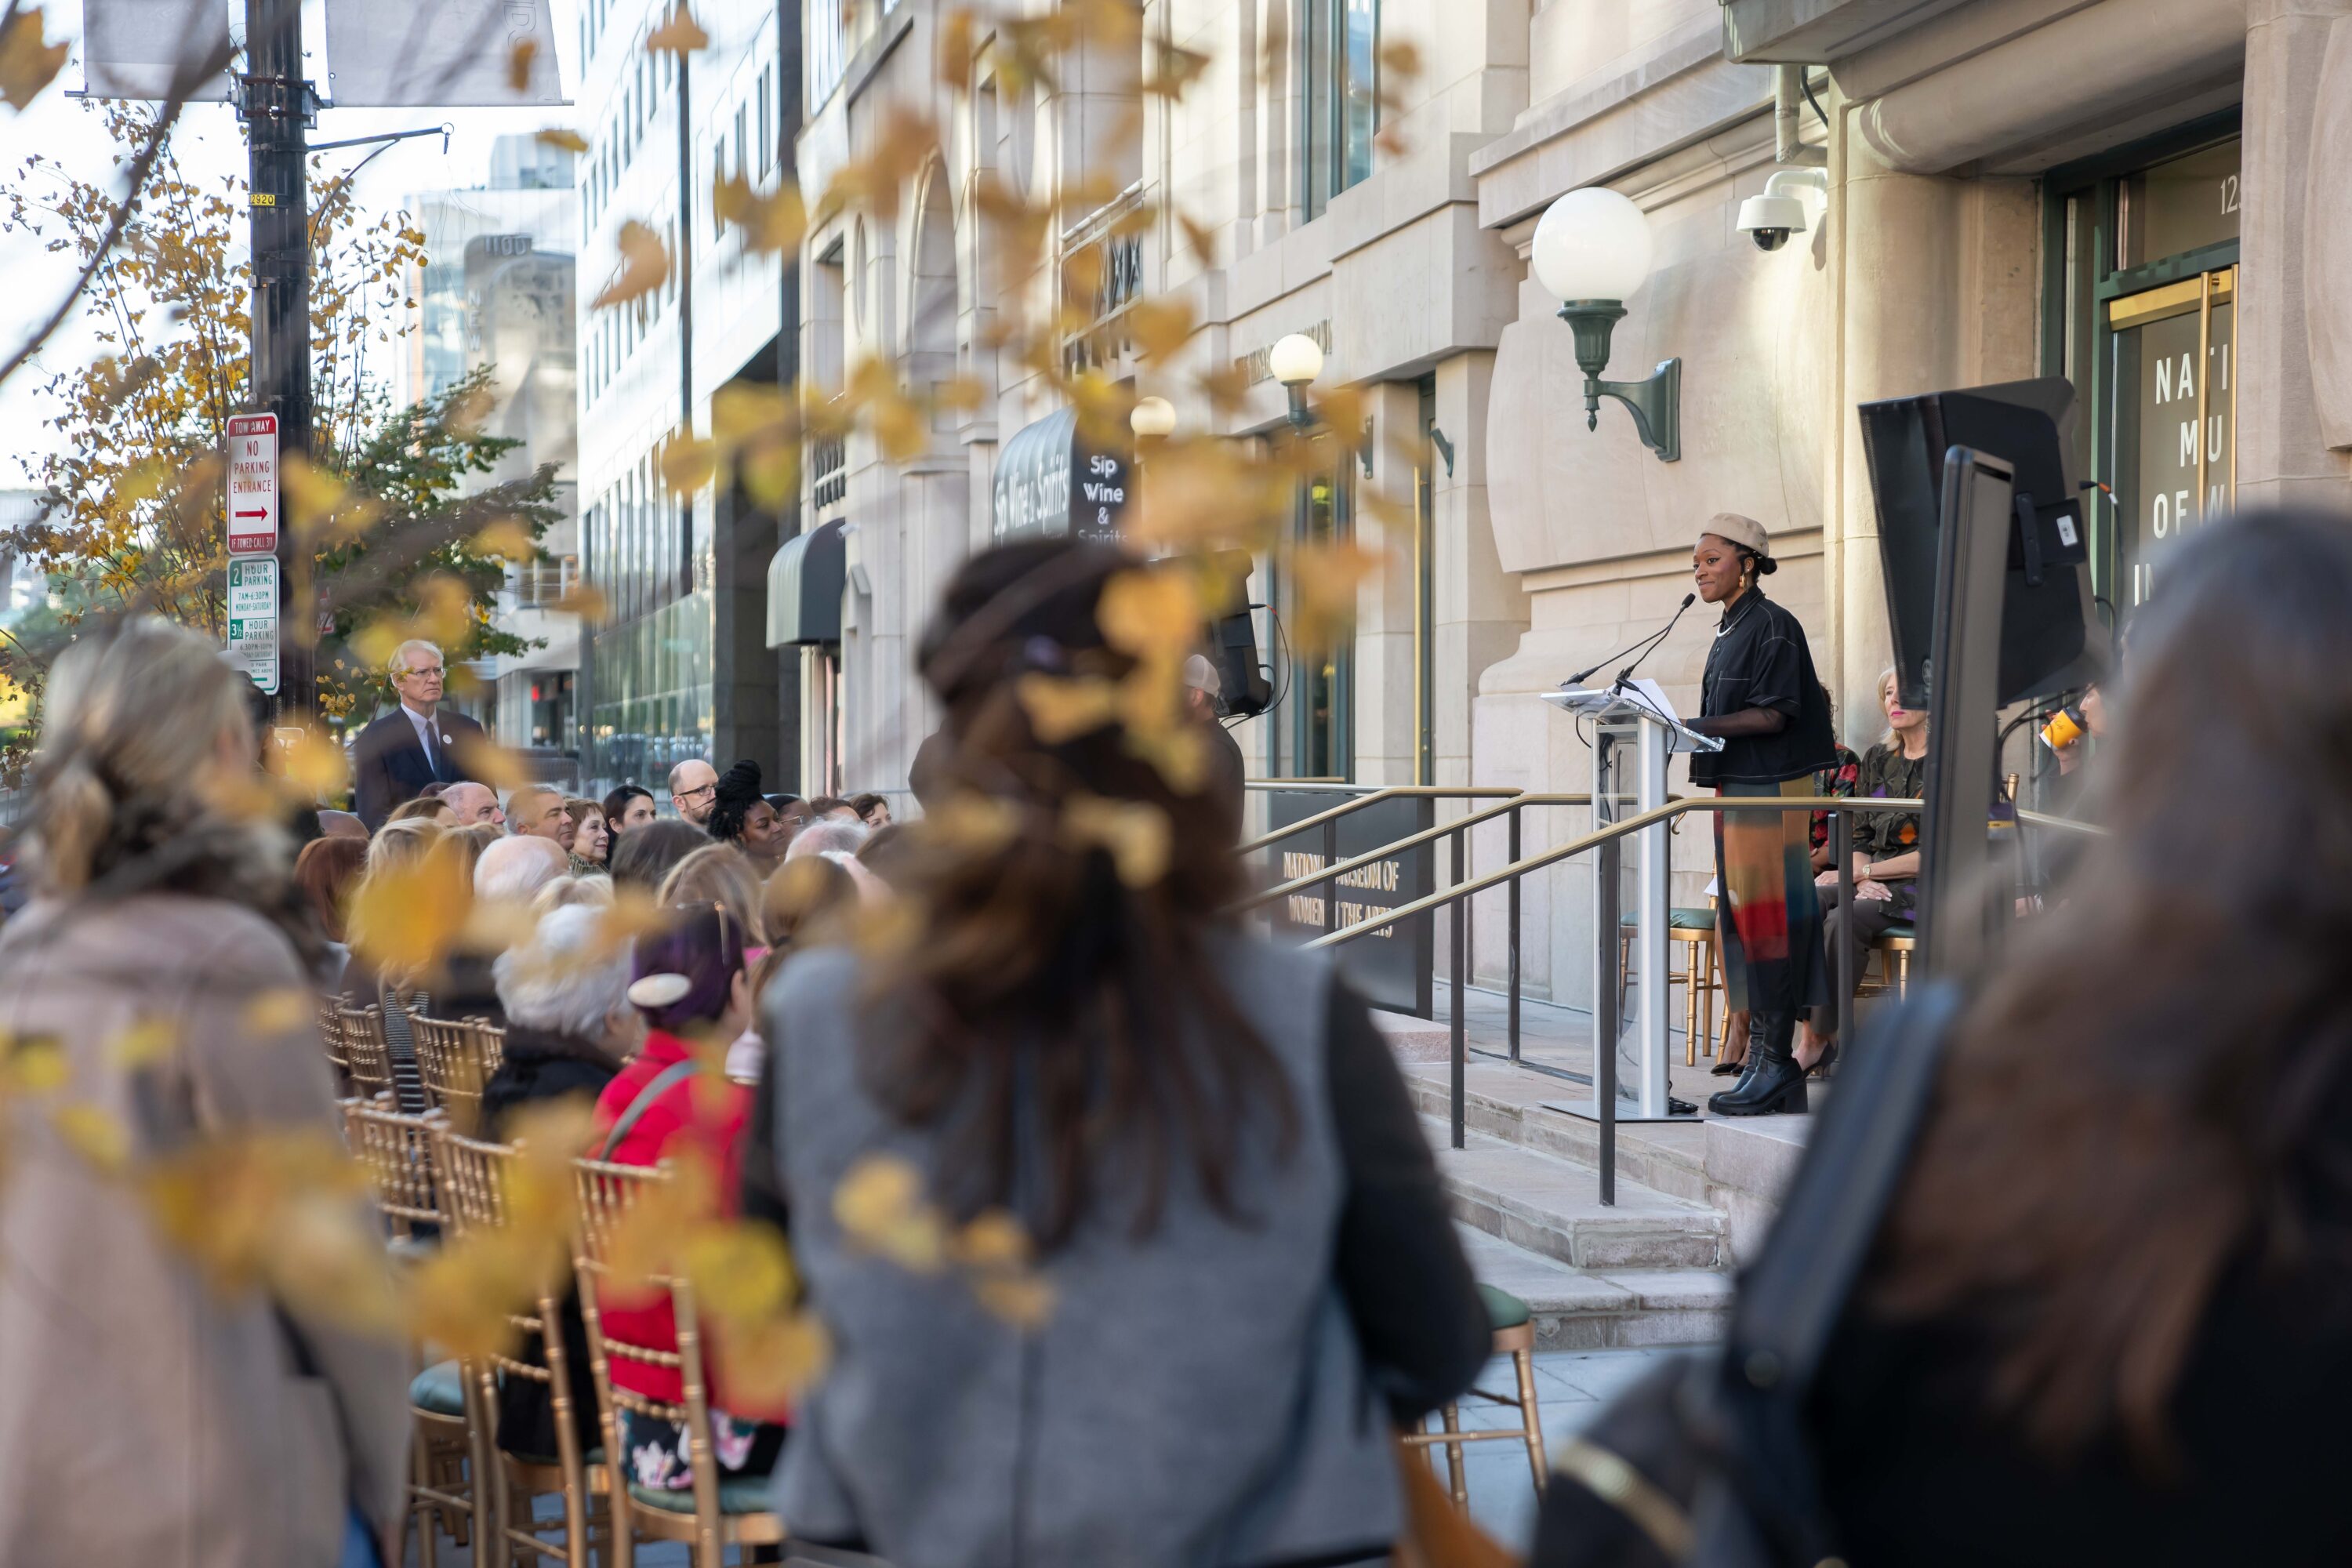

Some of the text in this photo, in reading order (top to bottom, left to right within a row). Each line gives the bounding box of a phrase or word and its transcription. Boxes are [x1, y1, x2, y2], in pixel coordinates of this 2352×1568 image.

[2220, 175, 2241, 215] 12
[468, 289, 481, 352] NEW
[235, 419, 270, 434] TOW AWAY
[246, 441, 259, 457] NO
[234, 461, 270, 475] PARKING
[1090, 455, 1117, 479] Sip
[234, 479, 272, 494] ENTRANCE
[1083, 482, 1124, 503] Wine
[993, 479, 1007, 547] Sip
[1008, 471, 1029, 528] Wine
[1036, 453, 1068, 535] Spirits
[1097, 506, 1109, 524] &
[2153, 489, 2189, 539] OF
[231, 539, 236, 549] IF
[238, 537, 252, 549] TOWED
[253, 536, 265, 548] CALL
[233, 568, 240, 585] 2
[245, 564, 268, 575] HOUR
[244, 575, 273, 586] PARKING
[235, 601, 271, 612] MONDAY-SATURDAY
[249, 620, 268, 630] HOUR
[245, 630, 274, 641] PARKING
[1382, 860, 1399, 891] OF
[1288, 894, 1324, 927] WOMEN
[1341, 902, 1363, 930] THE
